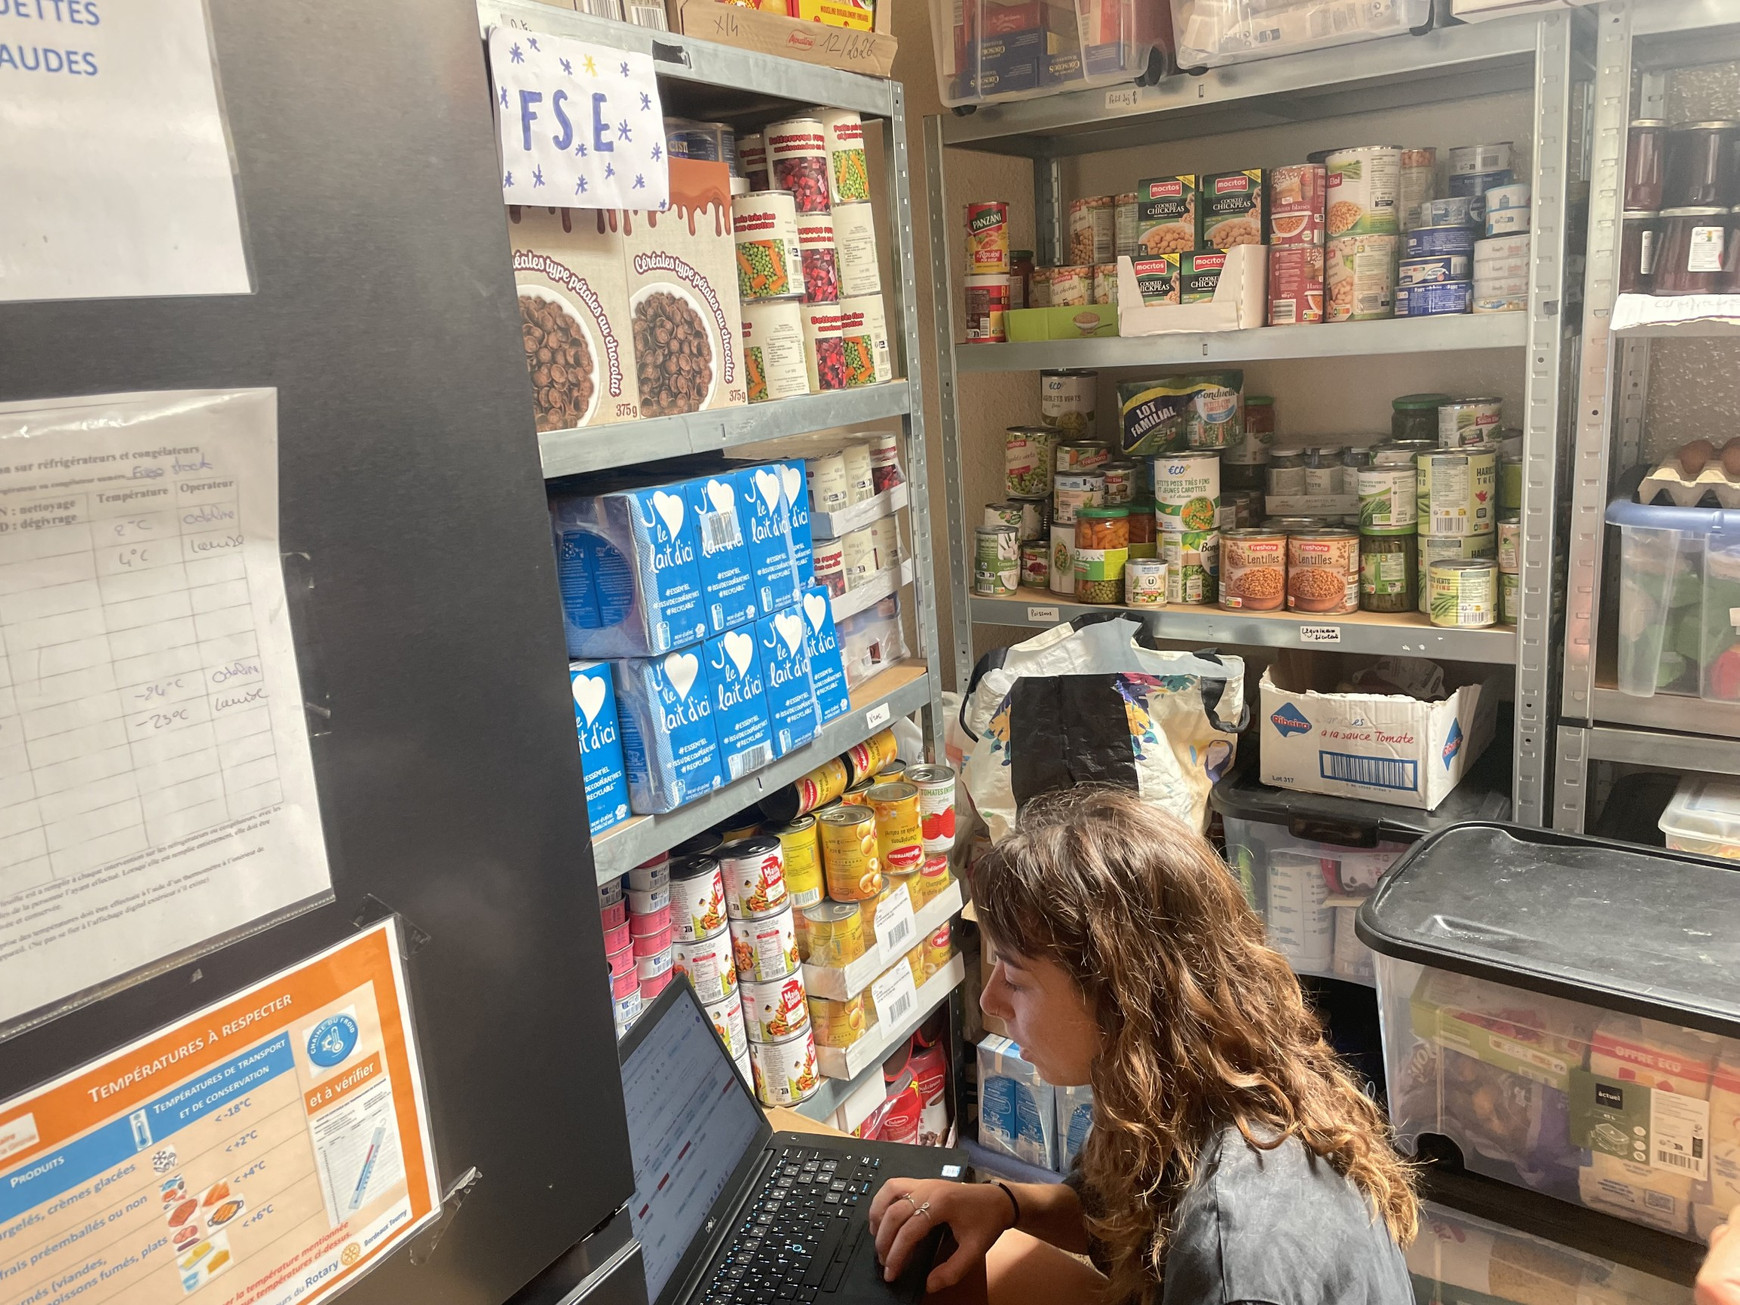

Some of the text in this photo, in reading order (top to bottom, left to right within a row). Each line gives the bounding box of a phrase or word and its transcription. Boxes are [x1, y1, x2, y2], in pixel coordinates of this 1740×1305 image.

[820, 32, 875, 60] 12/2026
[519, 89, 615, 153] FSE
[1151, 184, 1180, 194] mocitos
[1217, 179, 1246, 189] mocitos
[1147, 206, 1185, 216] CHICKPEAS
[1212, 201, 1251, 211] CHICKPEAS
[972, 212, 1001, 230] PANZANI
[1136, 263, 1165, 272] mocitos
[634, 251, 675, 275] Céréales
[674, 256, 697, 282] type
[692, 274, 721, 313] pétales
[714, 309, 728, 330] au
[1140, 283, 1170, 292] HICKPEAS
[545, 257, 624, 398] type pétales au chocolat
[1136, 401, 1157, 419] LOT
[1130, 407, 1177, 438] FAMILIAL
[119, 451, 129, 460] et
[96, 480, 234, 503] Température Operateur
[1181, 485, 1207, 493] CAROTTES
[19, 500, 75, 514] nettoyage
[756, 500, 767, 517] le
[792, 506, 809, 529] d'ici
[20, 514, 77, 530] dégivrage
[751, 517, 773, 543] lait
[657, 523, 669, 545] le
[648, 538, 695, 574] lait d'ici
[1247, 553, 1280, 565] Lentilles
[777, 643, 788, 661] le
[818, 631, 836, 654] d'ici
[725, 663, 737, 683] le
[770, 660, 794, 688] lait
[662, 687, 677, 705] le
[718, 674, 763, 711] lait d'ici
[660, 694, 712, 735] lait d'ici
[591, 720, 617, 751] d'ici
[1341, 732, 1371, 742] sauce
[1374, 730, 1415, 744] Tomate
[87, 994, 292, 1102] TEMPÉRATURES À RESPECTER
[1615, 1045, 1654, 1066] OFFRE
[153, 1039, 285, 1114] TEMPÉRATURES DE TRANSPORT
[310, 1061, 376, 1108] et à vérifier
[179, 1065, 269, 1119] ET DE CONSERVATION
[223, 1097, 252, 1119] -18°C
[233, 1129, 259, 1149] +2°C
[10, 1155, 66, 1189] PRODUITS
[242, 1160, 267, 1180] +4°C
[47, 1164, 136, 1215] crèmes glacées
[250, 1203, 275, 1222] +6°C
[30, 1219, 106, 1266] préemballés
[108, 1209, 123, 1222] ou
[125, 1196, 147, 1213] non
[301, 1221, 349, 1257] mentionnée
[99, 1236, 168, 1281] fumés, plats
[256, 1232, 352, 1299] températures ci-dessus.
[246, 1254, 299, 1293] température
[293, 1260, 338, 1297] du Rotary
